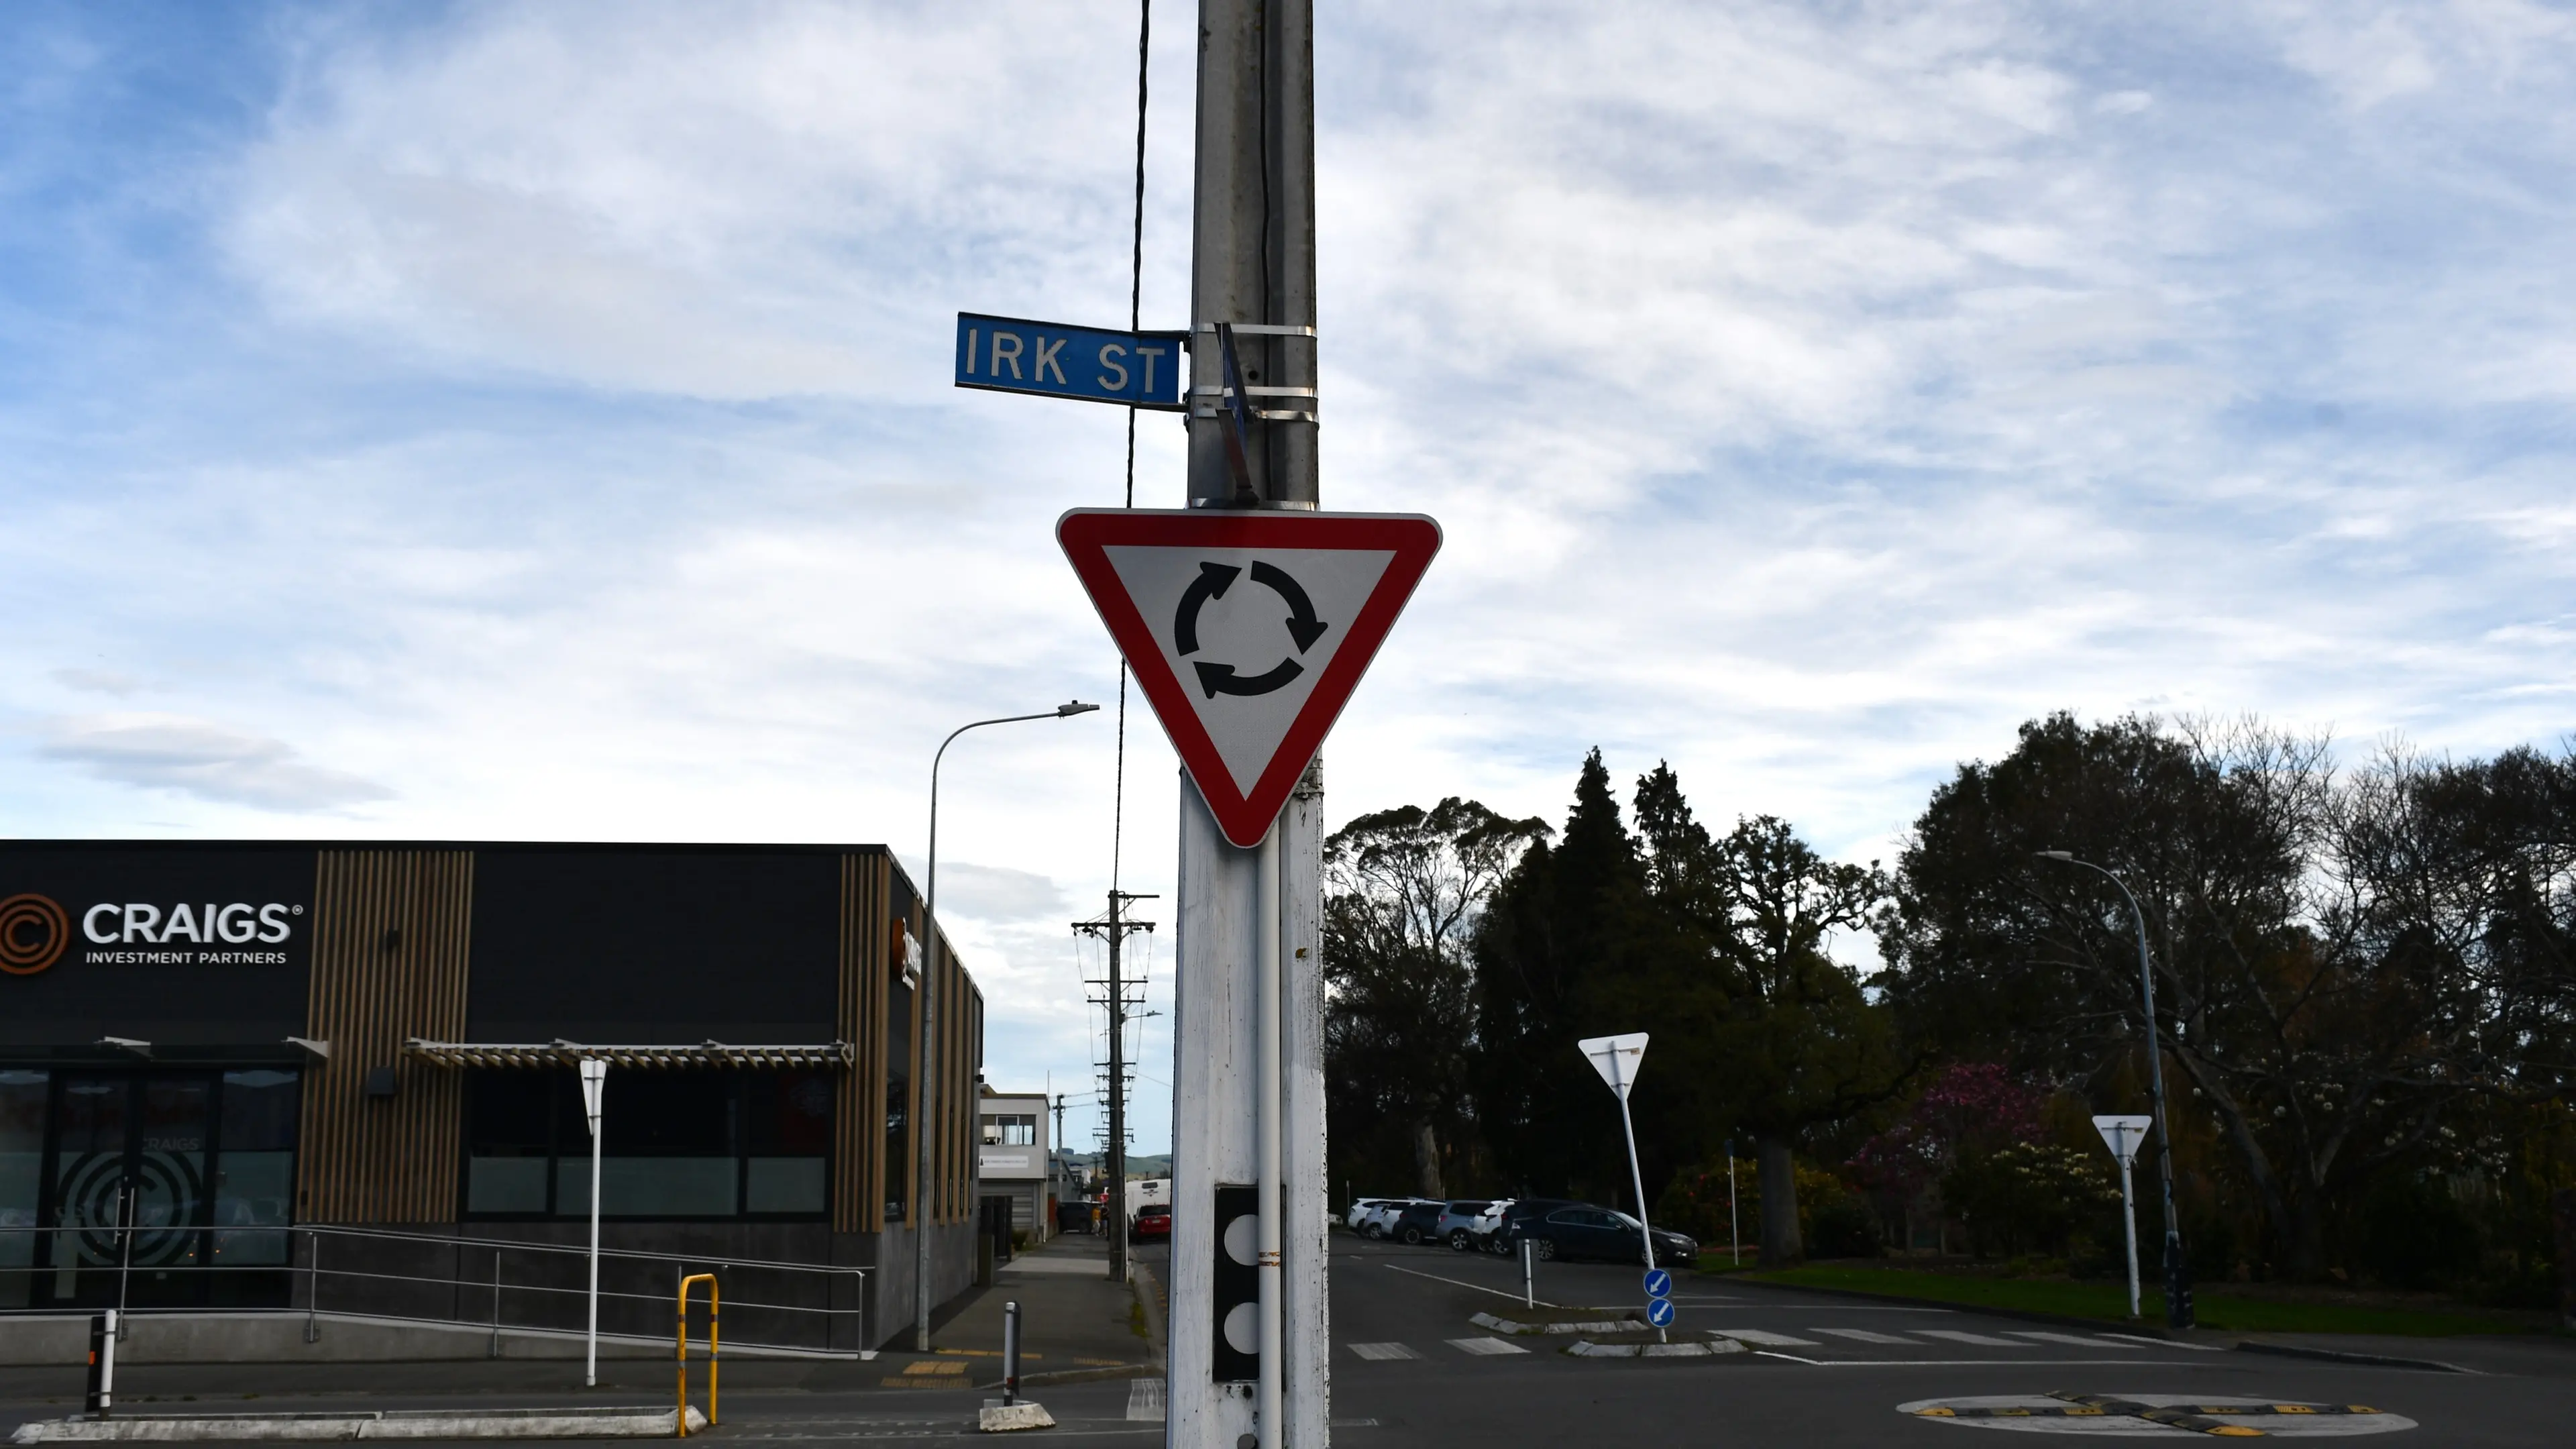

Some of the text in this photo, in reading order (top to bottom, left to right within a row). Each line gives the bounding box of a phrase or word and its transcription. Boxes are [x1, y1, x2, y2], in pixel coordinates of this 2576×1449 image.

[967, 329, 1067, 384] IRK
[1097, 344, 1165, 393] ST
[86, 952, 286, 964] INVESTMENT PARTNERS
